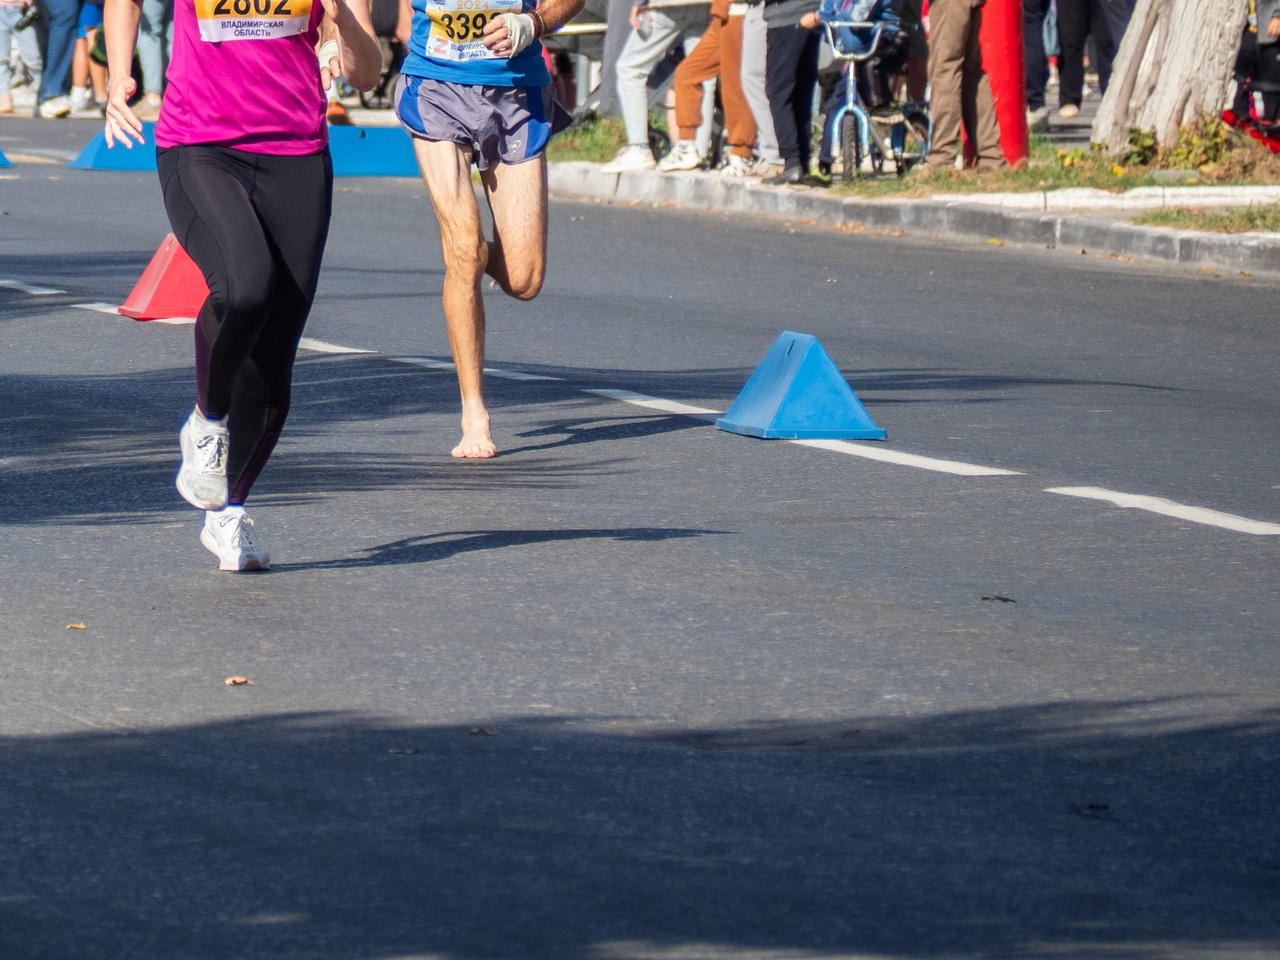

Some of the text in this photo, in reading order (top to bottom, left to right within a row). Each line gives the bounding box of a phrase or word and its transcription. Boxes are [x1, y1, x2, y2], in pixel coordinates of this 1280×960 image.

[456, 0, 490, 10] 2024
[221, 21, 284, 29] ВЛАДИМИРСКАЯ
[440, 12, 502, 40] 339
[234, 29, 271, 37] ОБЛАСТЬ
